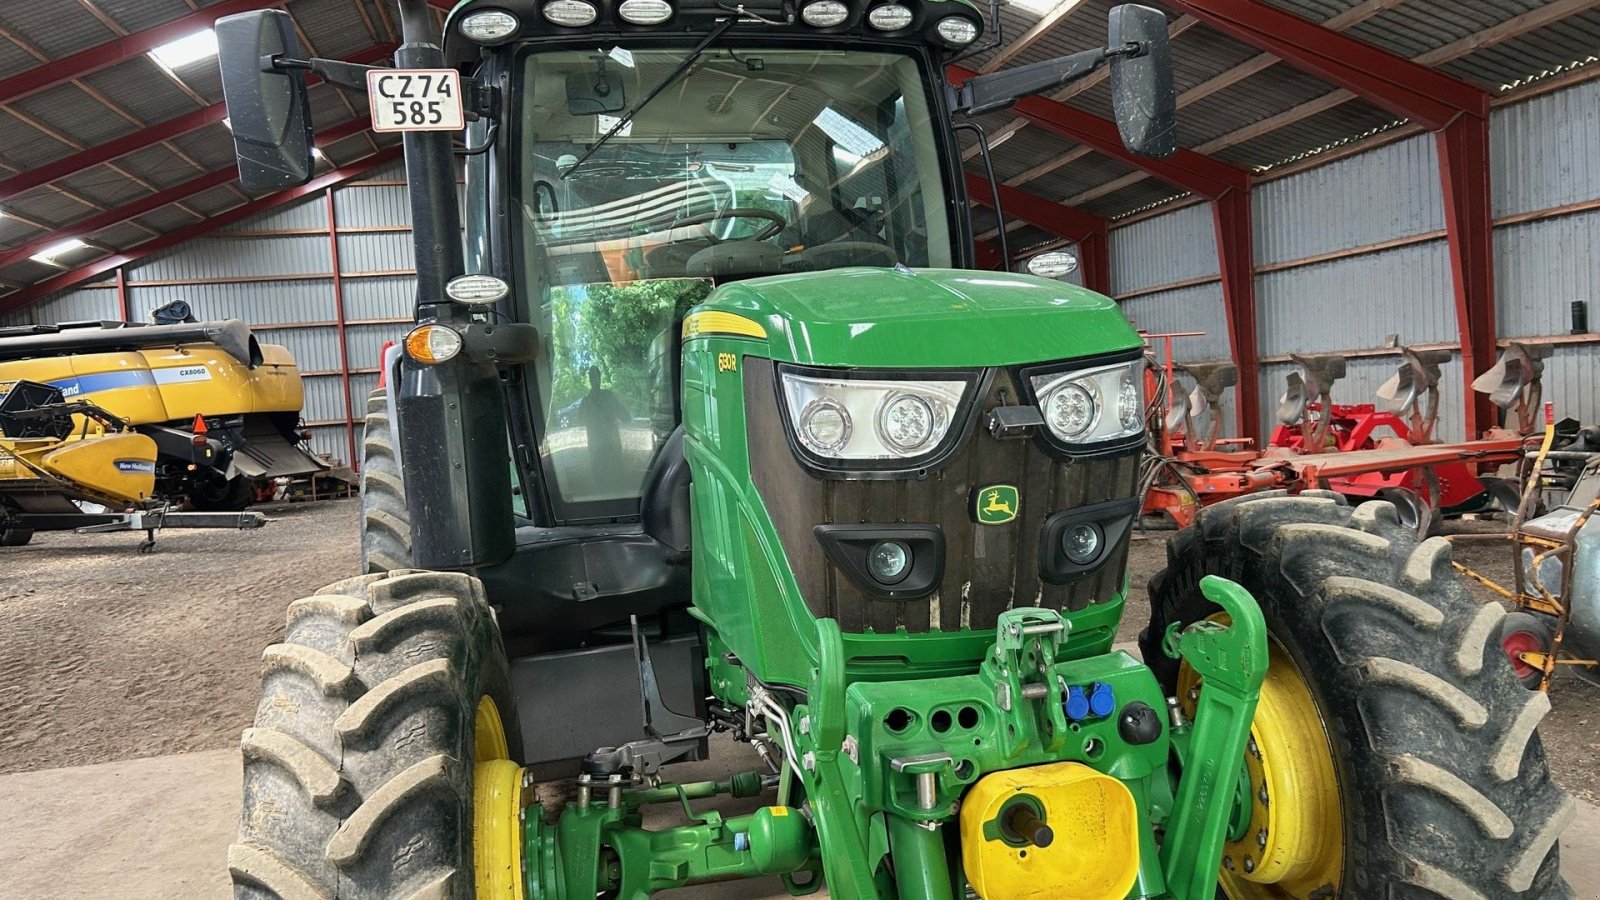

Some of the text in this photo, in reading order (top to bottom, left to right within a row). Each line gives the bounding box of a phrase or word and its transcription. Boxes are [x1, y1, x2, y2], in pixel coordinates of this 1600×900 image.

[378, 75, 451, 98] CZ74
[393, 101, 442, 125] 585
[179, 368, 206, 376] CX8060
[120, 462, 131, 470] New
